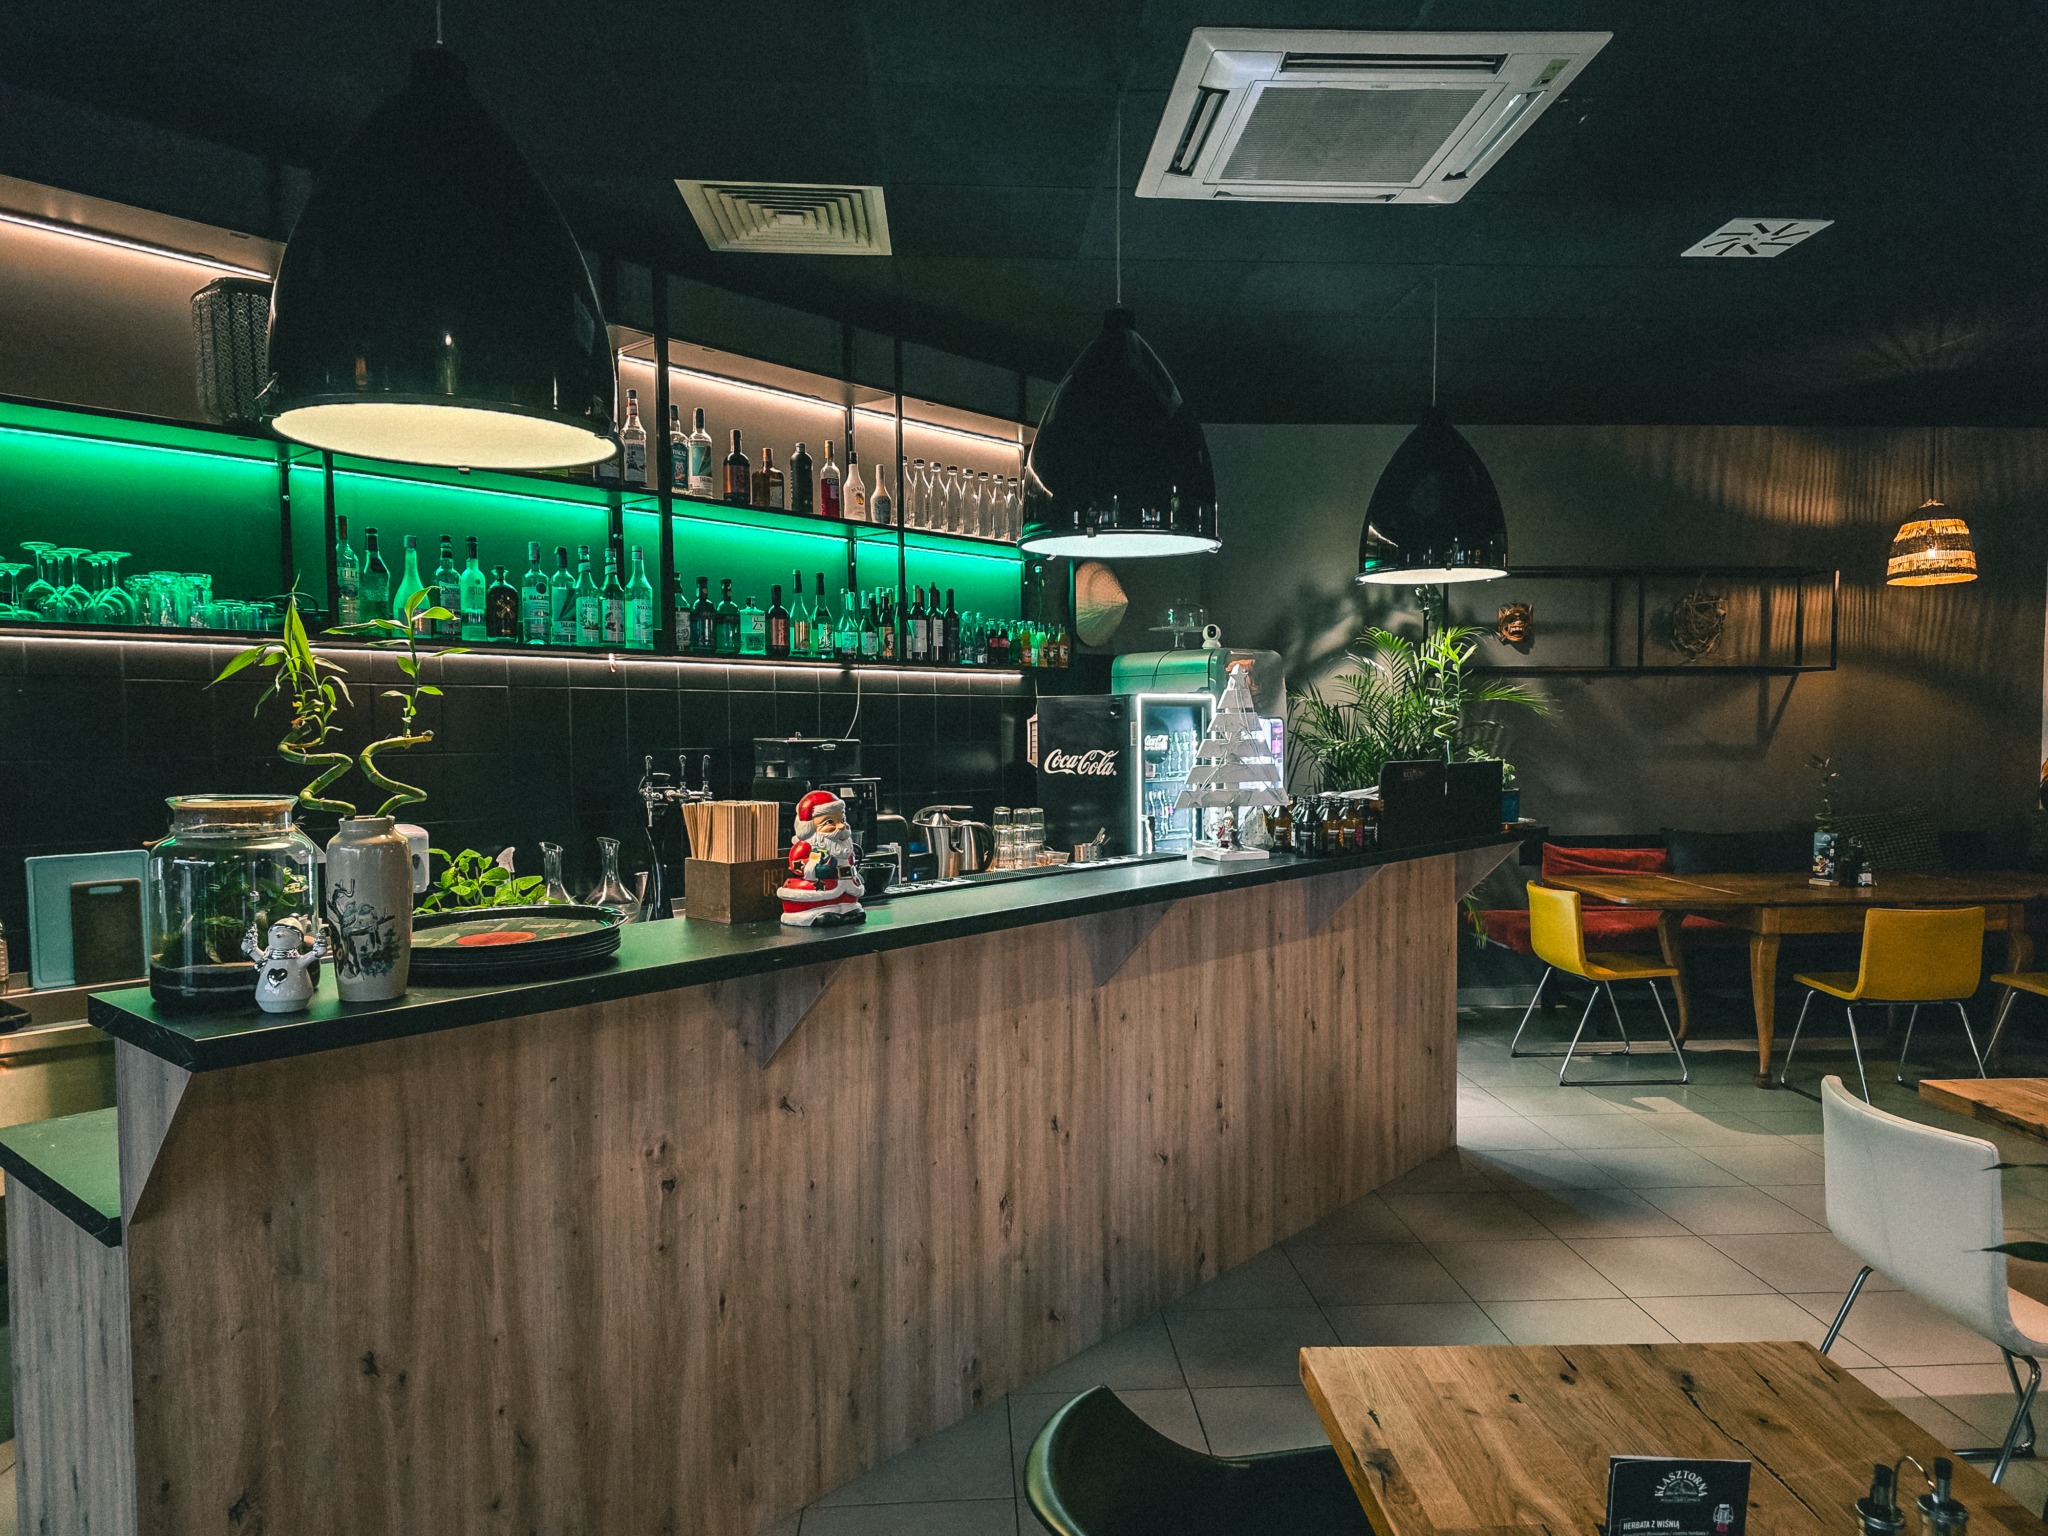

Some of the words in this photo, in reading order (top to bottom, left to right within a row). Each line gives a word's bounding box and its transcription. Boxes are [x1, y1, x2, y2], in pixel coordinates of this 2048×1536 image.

[1043, 748, 1119, 776] Coca-Cola
[1654, 1470, 1708, 1497] KLASZTORNA
[1623, 1520, 1650, 1530] HERBATA
[1651, 1520, 1656, 1528] Z
[1657, 1518, 1680, 1530] WIŚNIĄ
